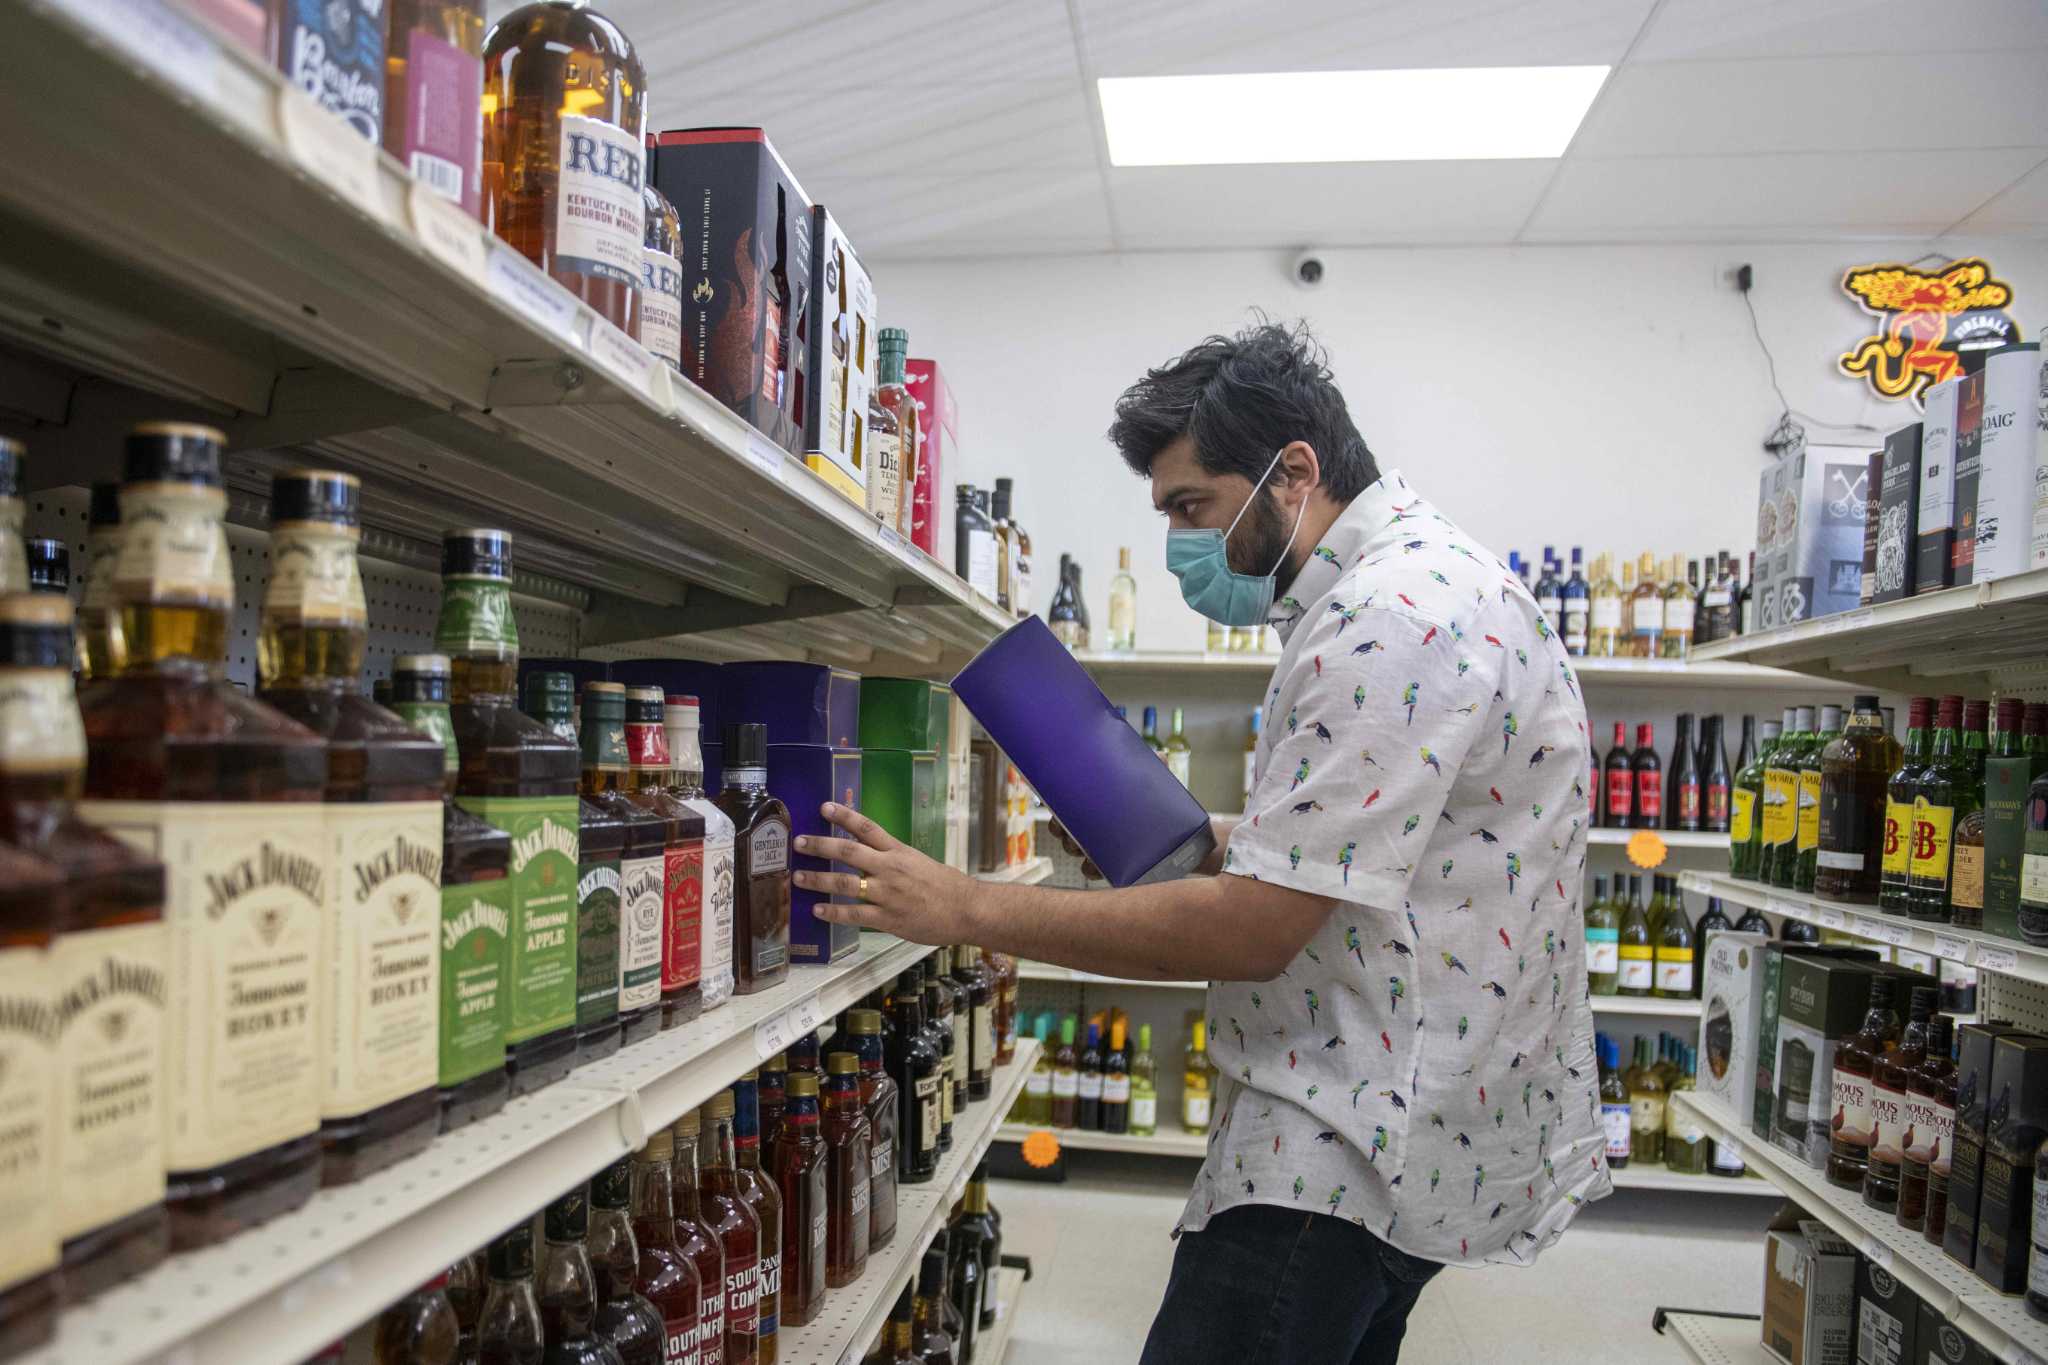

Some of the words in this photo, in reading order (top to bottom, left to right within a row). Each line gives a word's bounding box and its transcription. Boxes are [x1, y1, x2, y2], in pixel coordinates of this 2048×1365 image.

[567, 193, 616, 215] KENTUCKY
[567, 205, 613, 226] BOURBON
[703, 197, 711, 214] TAKES
[701, 256, 709, 271] JACK
[1953, 316, 2010, 339] FIREBALL
[698, 350, 706, 364] MAKE
[1883, 478, 1897, 489] PARK
[512, 827, 543, 873] JACK
[754, 839, 786, 852] GENTLEMAN
[764, 850, 777, 861] JACK
[355, 850, 394, 903] JACK
[204, 859, 256, 923] JACK
[626, 880, 645, 908] JACK
[642, 906, 655, 920] RYE
[443, 908, 474, 950] JACK
[526, 928, 567, 952] APPLE
[1718, 950, 1728, 961] OLD
[369, 975, 431, 1008] HONEY
[460, 993, 497, 1018] APPLE
[226, 1002, 308, 1041] HONEY
[871, 1149, 892, 1178] MIST
[666, 1327, 700, 1357] OUTH
